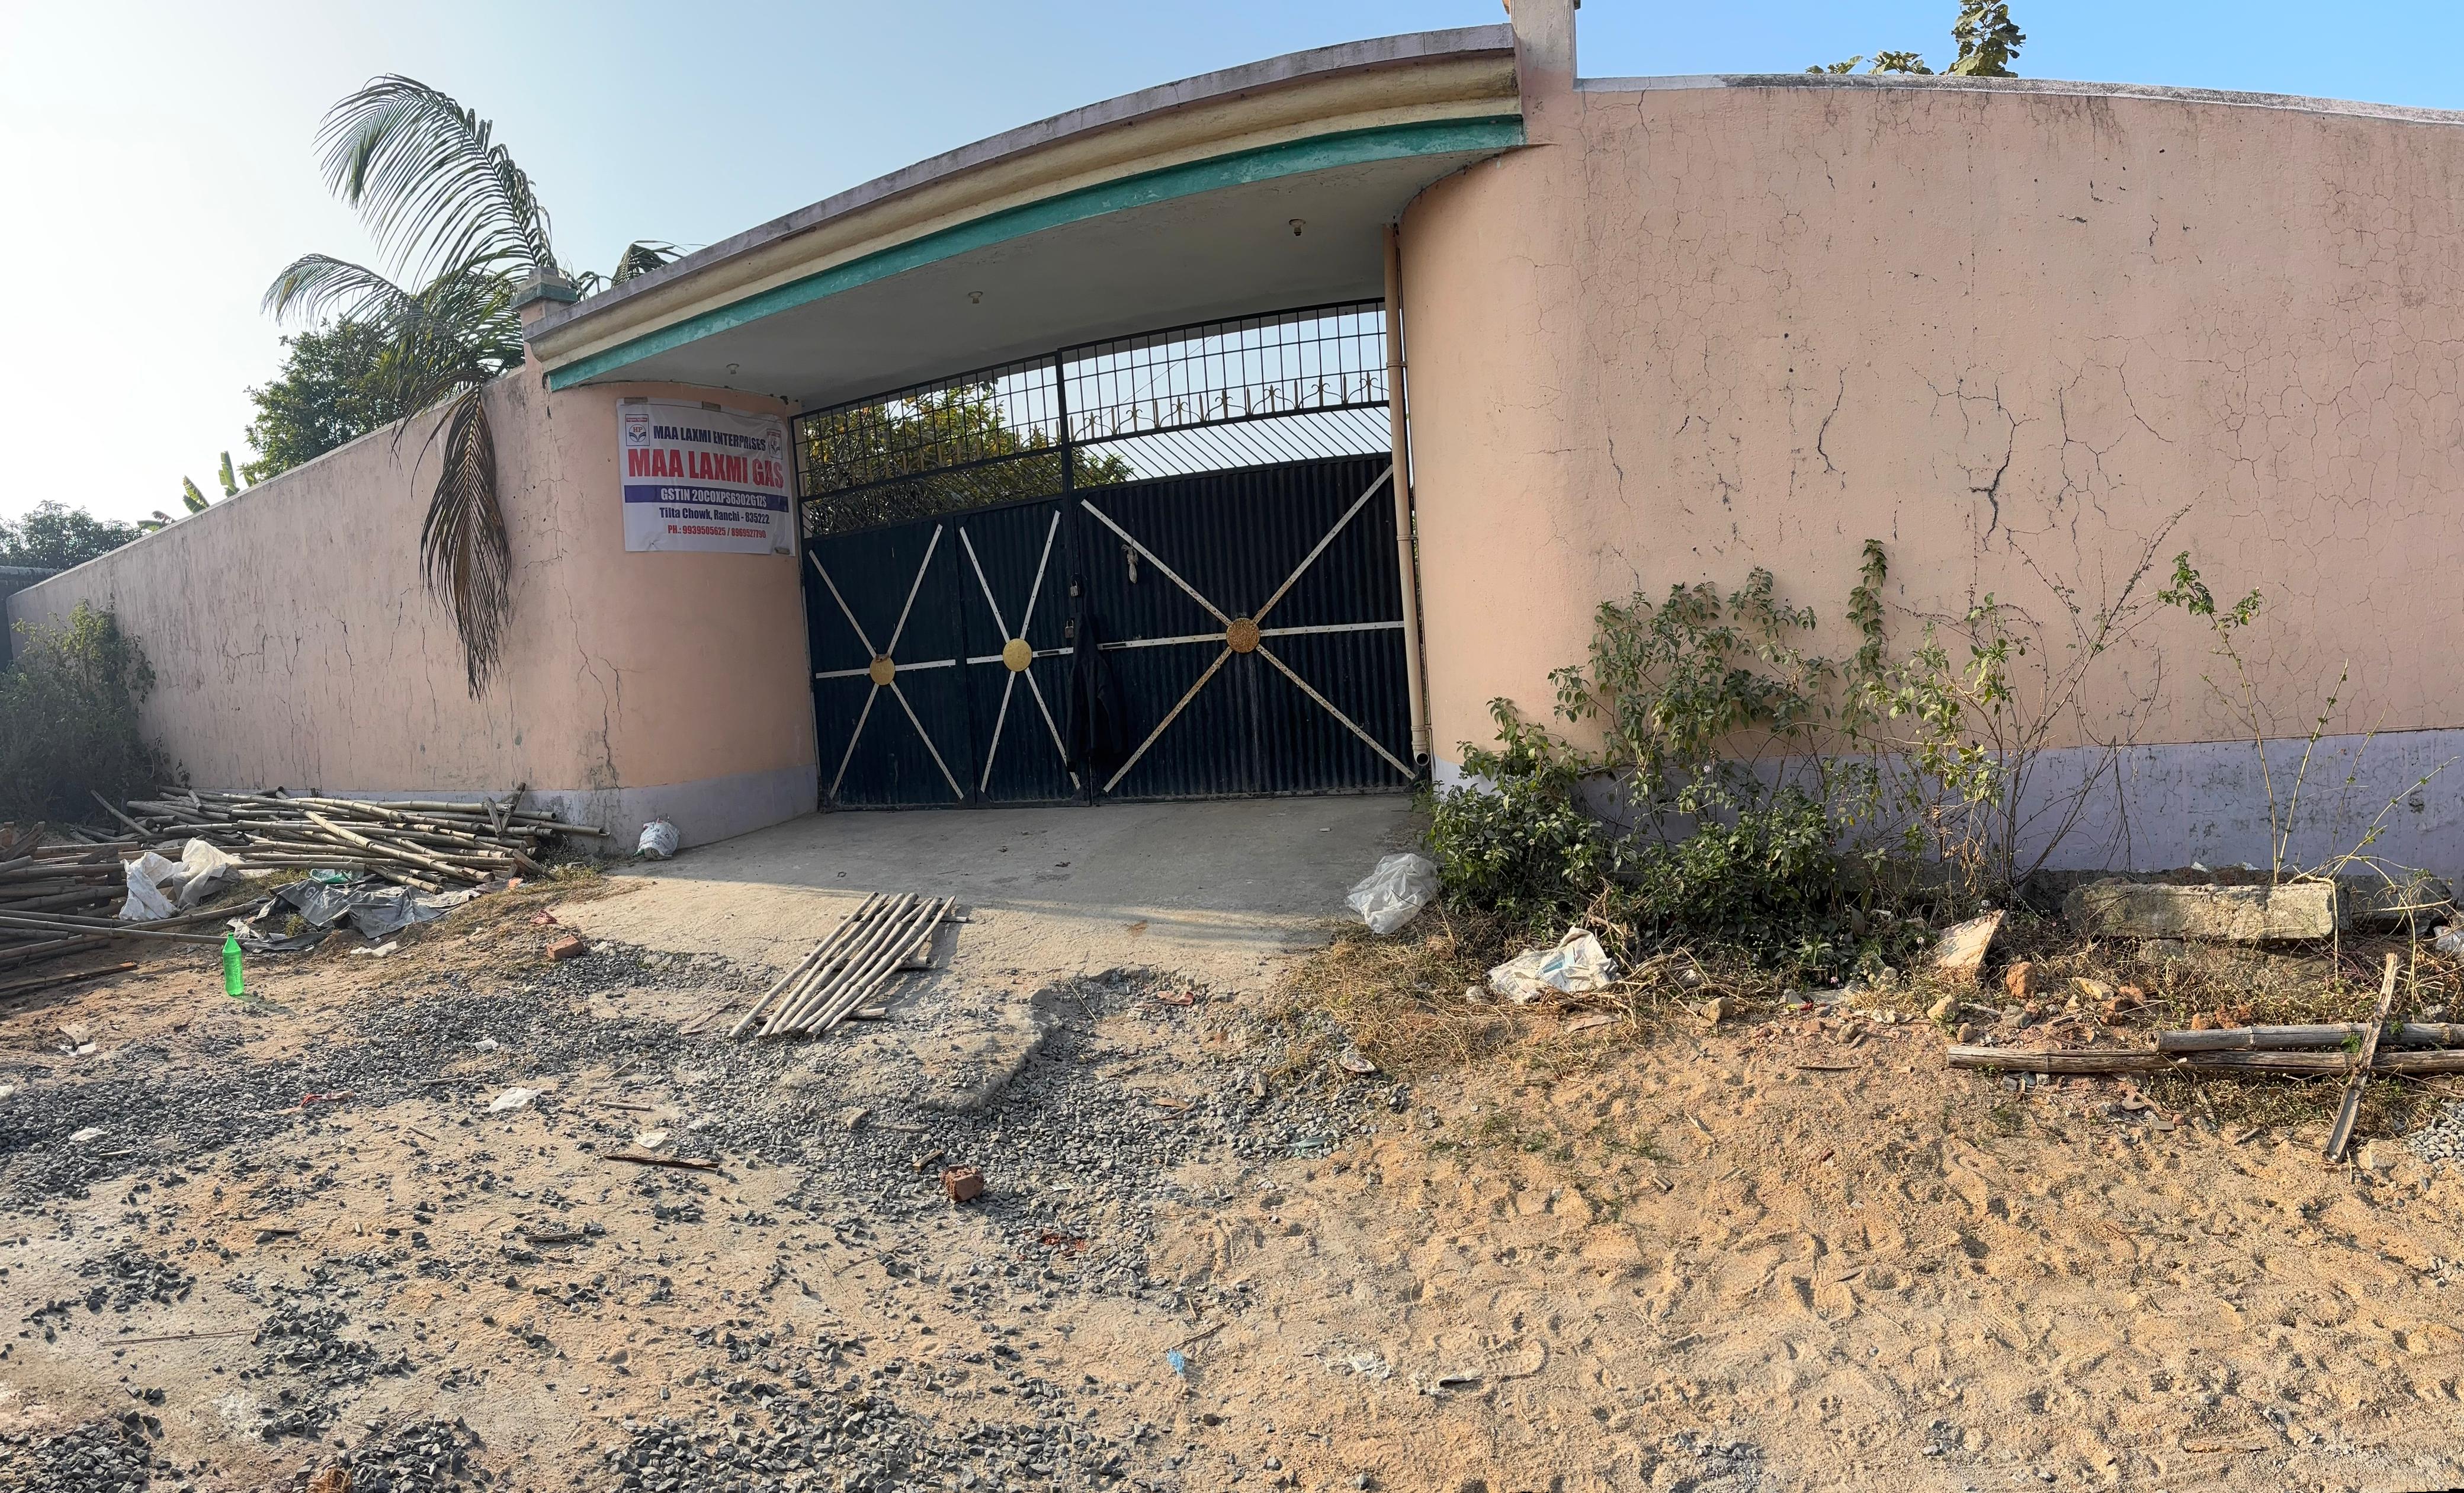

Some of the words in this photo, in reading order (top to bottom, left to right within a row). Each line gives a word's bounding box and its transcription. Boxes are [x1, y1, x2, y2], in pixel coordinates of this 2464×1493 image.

[653, 425, 679, 440] MAA
[681, 427, 711, 443] LAXMI
[713, 431, 766, 451] ENTERPRISES
[628, 448, 684, 477] MAA
[688, 451, 748, 483] LAXMI
[752, 459, 784, 489] GAS
[660, 488, 690, 501] GSTIN
[659, 507, 681, 518] Tilta
[682, 508, 713, 521] Chowk,
[714, 510, 740, 521] Ranchi
[745, 512, 770, 524] 835222
[682, 526, 726, 536] 9939505625
[727, 527, 730, 536] /
[731, 528, 766, 539] 8969527790
